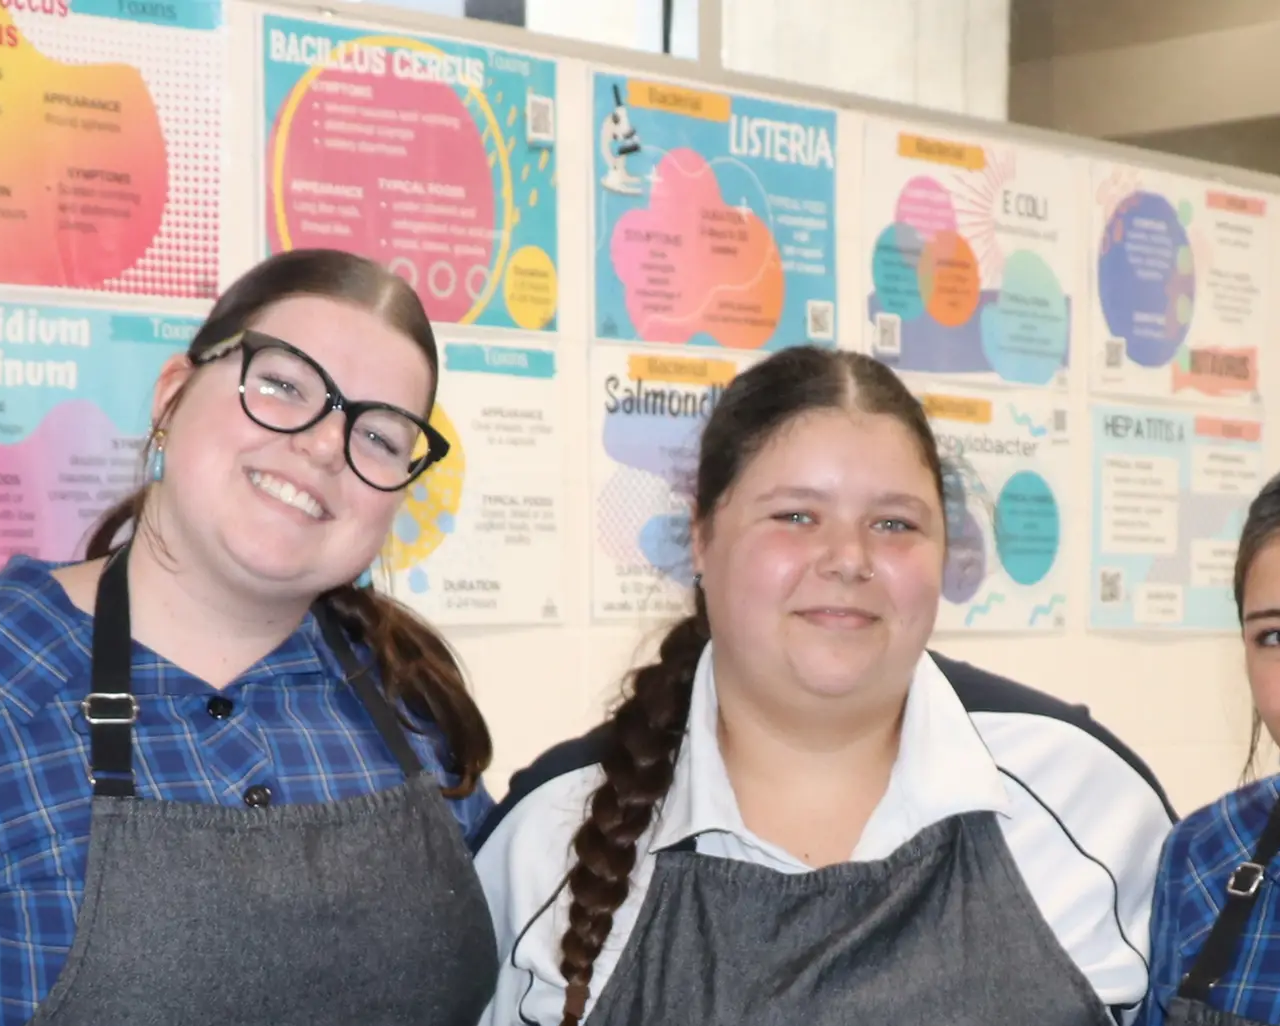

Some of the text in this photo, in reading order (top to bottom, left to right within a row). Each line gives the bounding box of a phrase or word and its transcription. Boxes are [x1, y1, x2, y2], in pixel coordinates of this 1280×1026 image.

[270, 29, 485, 87] BACILLUS CEREUS
[728, 113, 835, 169] LISTERIA
[483, 349, 529, 368] Toxins
[1104, 413, 1175, 443] HEPATITIS
